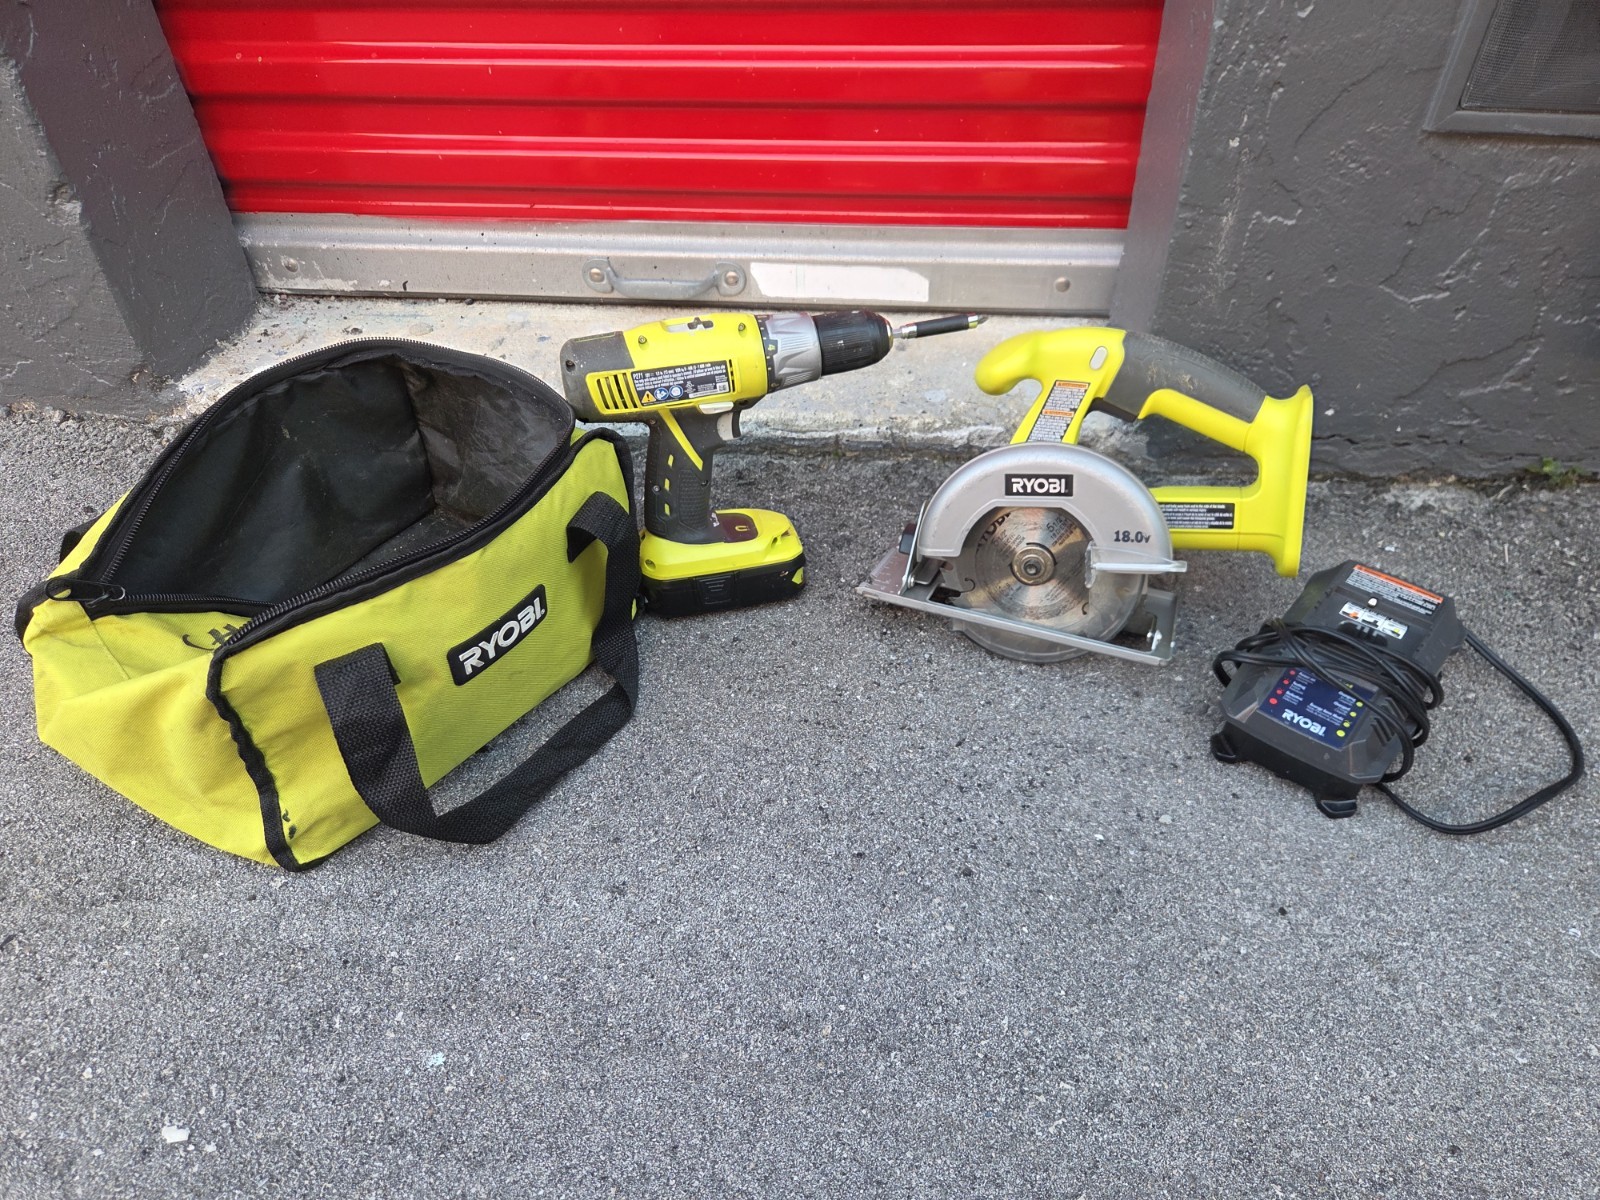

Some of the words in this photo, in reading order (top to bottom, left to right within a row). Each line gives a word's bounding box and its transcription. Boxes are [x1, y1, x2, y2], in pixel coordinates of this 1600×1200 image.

[1011, 478, 1066, 494] RYOBI
[459, 597, 544, 675] RYOBI
[1282, 708, 1326, 736] RYOBI
